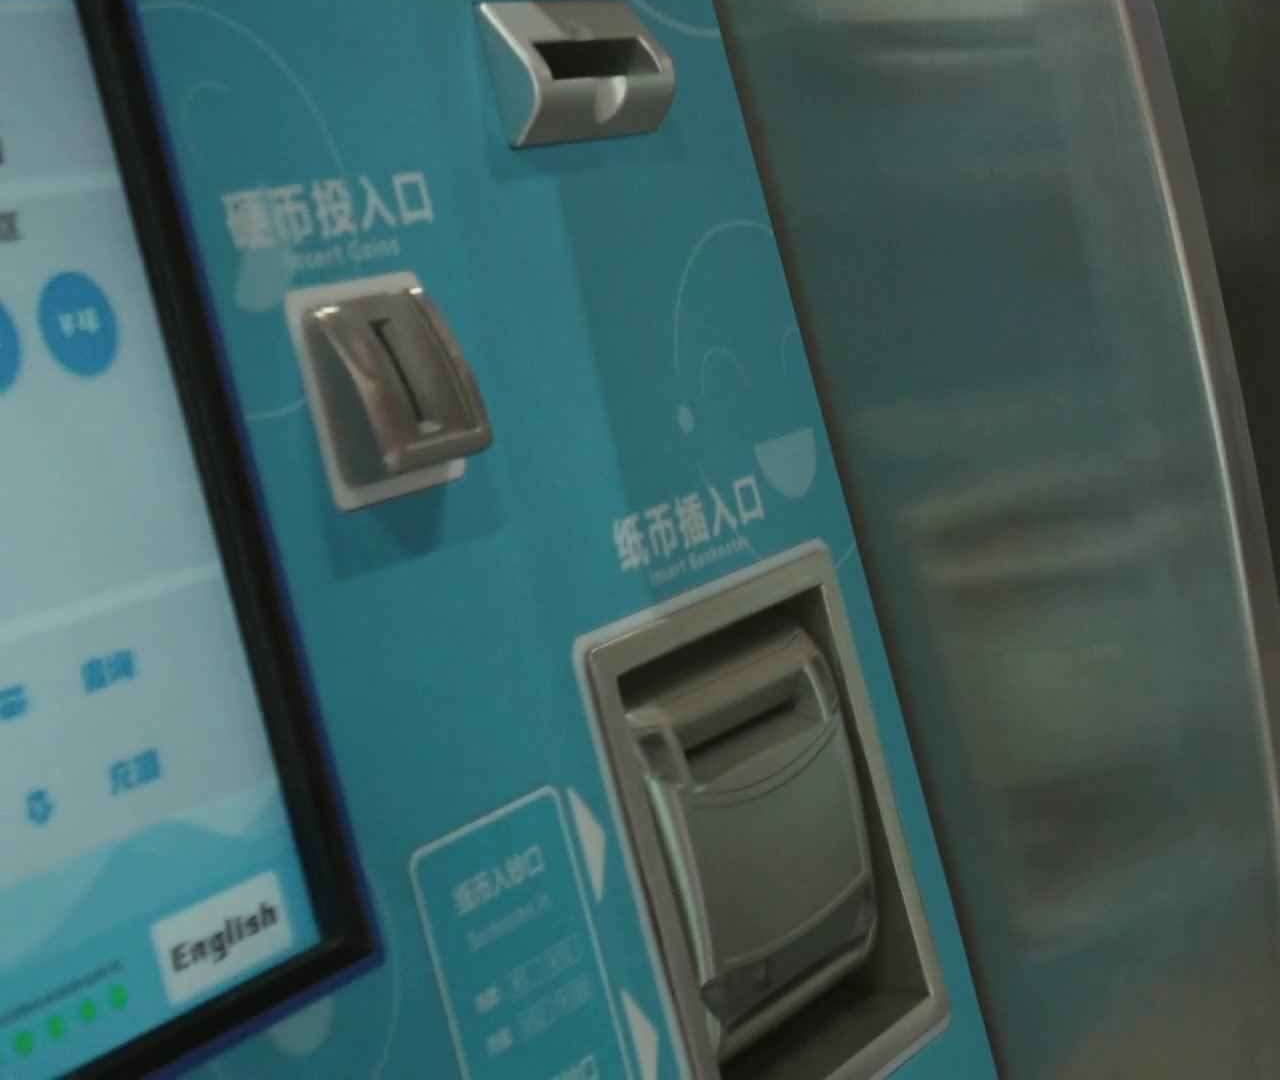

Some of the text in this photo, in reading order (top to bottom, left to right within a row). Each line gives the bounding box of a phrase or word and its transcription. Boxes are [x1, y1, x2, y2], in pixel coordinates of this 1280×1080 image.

[221, 171, 434, 251] 硬币投入口
[611, 475, 765, 572] 纸币插入口
[169, 902, 279, 973] English
